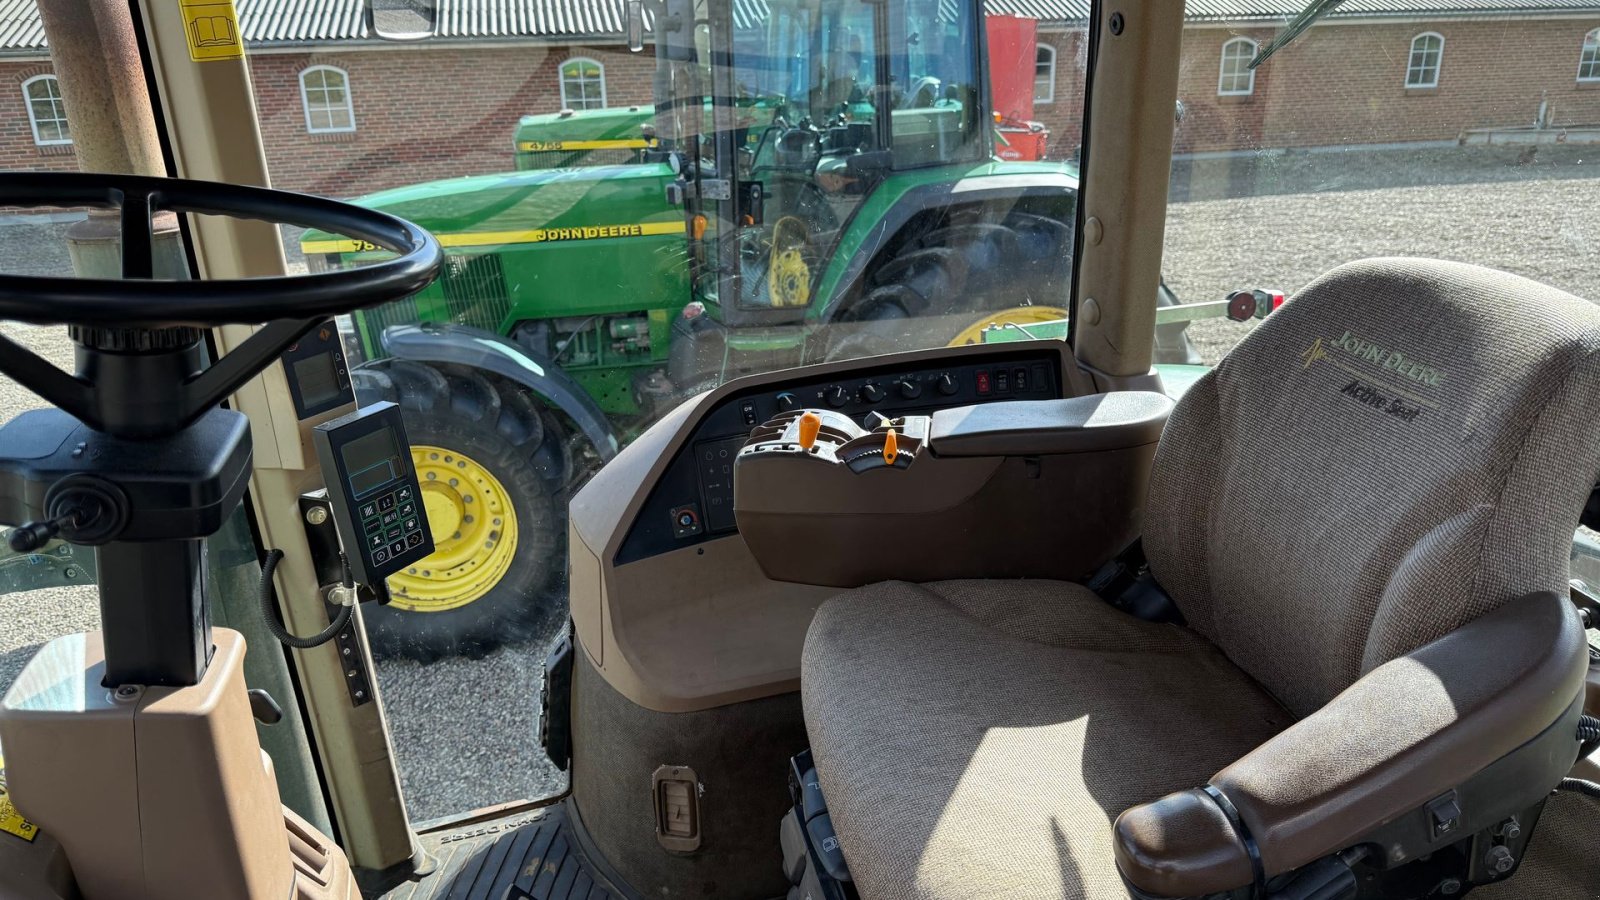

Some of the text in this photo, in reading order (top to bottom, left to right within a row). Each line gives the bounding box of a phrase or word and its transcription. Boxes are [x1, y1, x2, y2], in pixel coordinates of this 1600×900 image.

[537, 224, 642, 242] JOHN DEERE
[1330, 330, 1447, 387] JOHN DEERE
